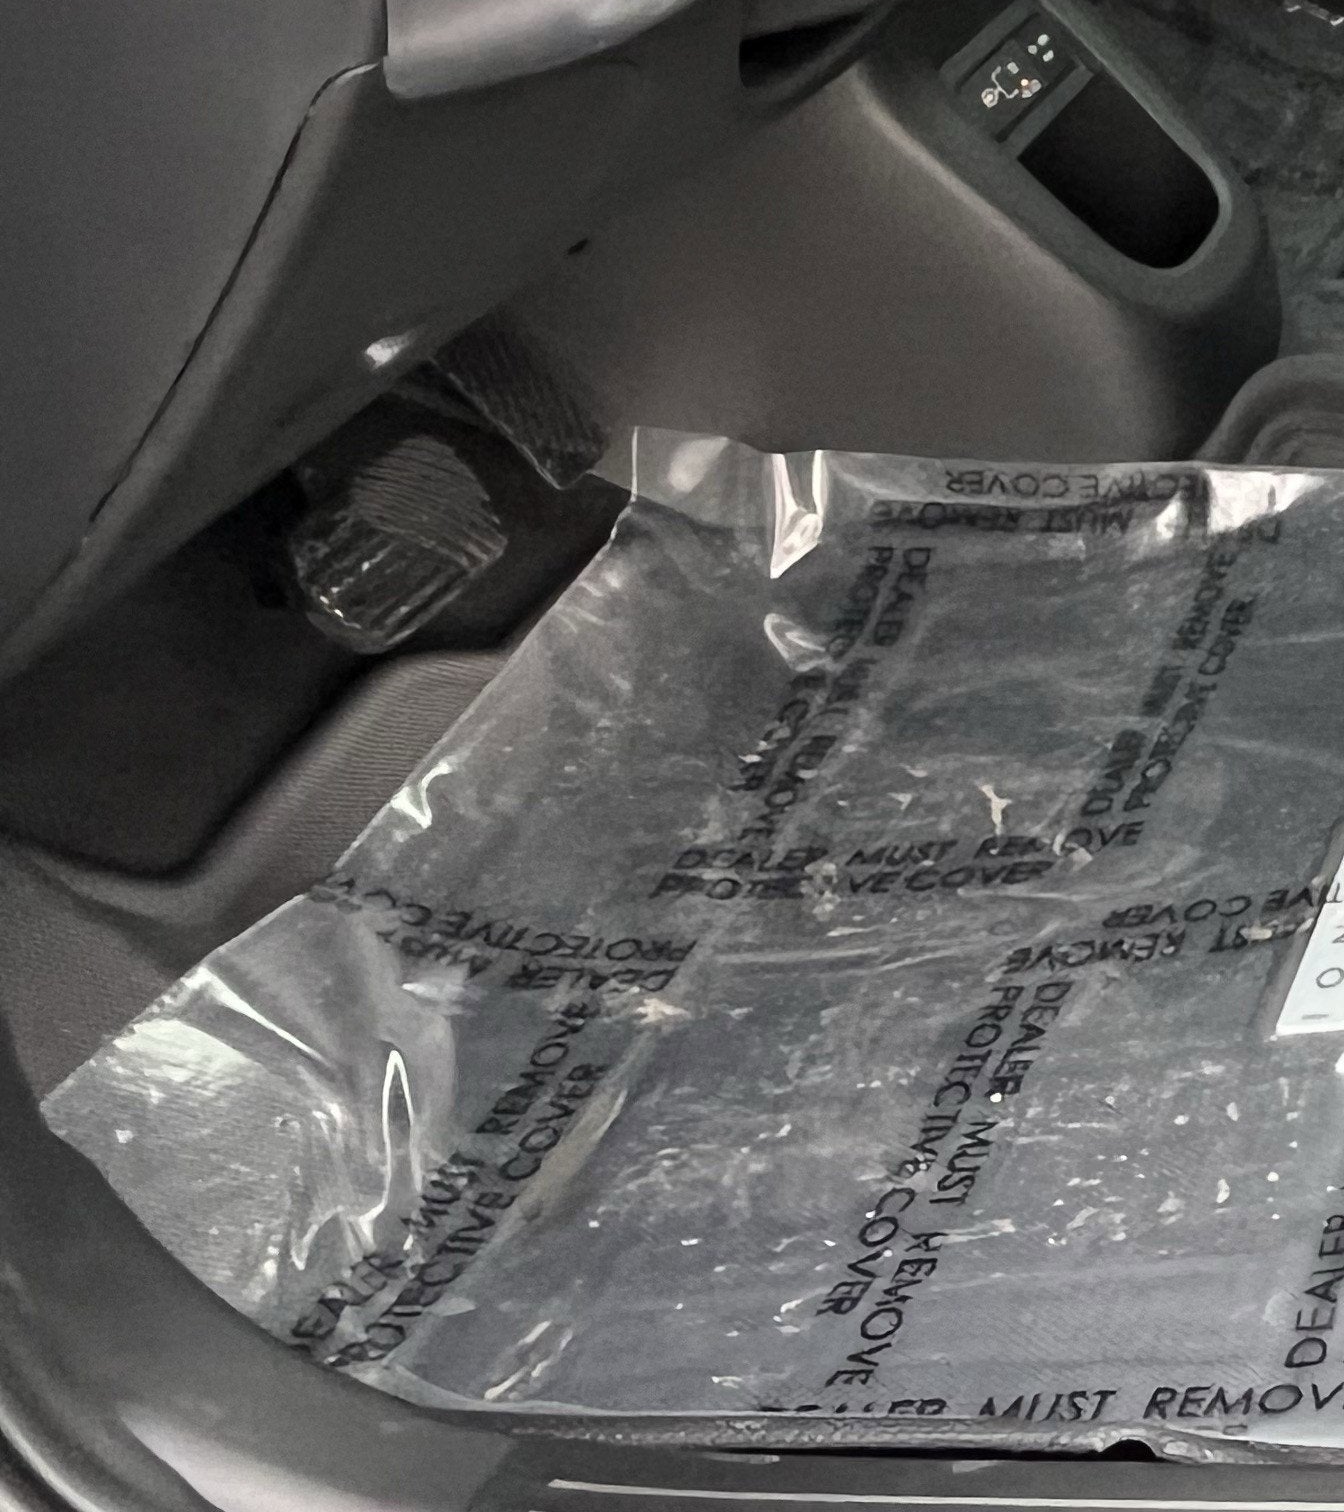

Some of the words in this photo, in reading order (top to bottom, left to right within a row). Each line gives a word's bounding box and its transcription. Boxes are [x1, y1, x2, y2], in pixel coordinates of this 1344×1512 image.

[944, 470, 1069, 498] COVER
[1103, 897, 1253, 931] COVER
[986, 980, 1076, 1098] DEALER
[499, 1061, 609, 1182] COVER
[928, 1118, 1000, 1206] MUST
[813, 1185, 916, 1318] COVER
[823, 1230, 951, 1388] REMOVE
